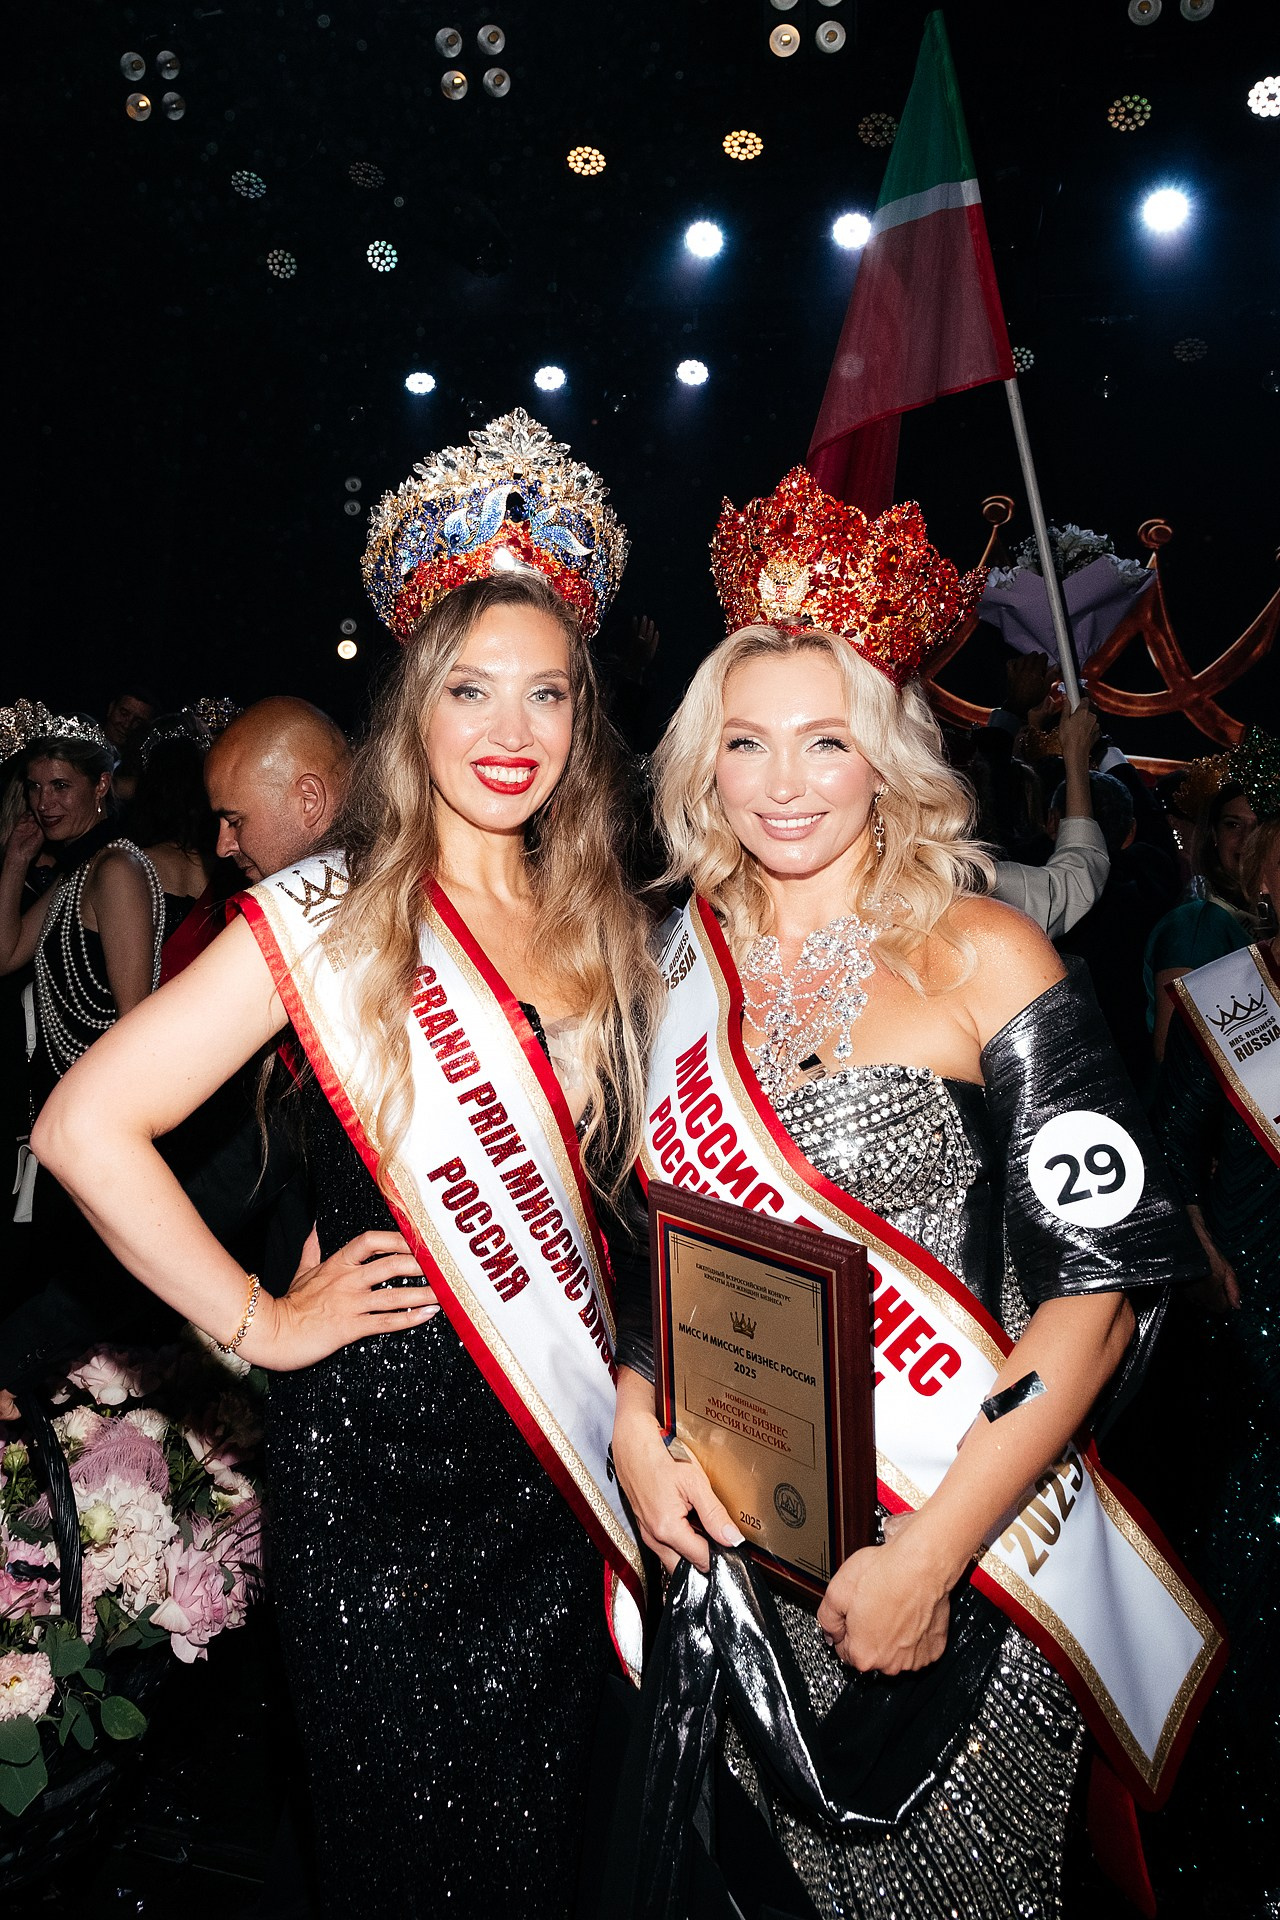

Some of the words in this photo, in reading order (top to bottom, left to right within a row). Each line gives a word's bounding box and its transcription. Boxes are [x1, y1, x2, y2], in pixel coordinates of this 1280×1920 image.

[1229, 1035, 1246, 1048] MRS.
[1245, 1015, 1276, 1038] BUSINESS
[1234, 1024, 1280, 1062] RUSSIA
[410, 965, 481, 1084] GRAND
[457, 1081, 527, 1167] PRIX
[500, 1159, 590, 1302] МИССИС
[675, 1032, 785, 1216] МИССИС
[1044, 1143, 1126, 1206] 29
[427, 1156, 531, 1303] РОССИЯ
[695, 1262, 726, 1278] ЕЖЕГОДНЫЙ
[725, 1273, 767, 1292] ВСЕРОССИЙСКИЙ
[767, 1288, 791, 1302] КОНКУРС
[703, 1272, 726, 1285] КРАСОТЫ
[725, 1281, 736, 1289] ДЛЯ
[736, 1284, 760, 1299] ЖЕНЩИН
[760, 1293, 783, 1306] БИЗНЕСА
[678, 1322, 701, 1339] МИСС
[702, 1331, 709, 1342] И
[710, 1335, 745, 1357] МИССИС
[745, 1349, 779, 1372] БИЗНЕС
[780, 1364, 817, 1387] РОССИЯ
[733, 1361, 757, 1379] 2025
[707, 1396, 751, 1422] «МИССИС
[752, 1414, 789, 1439] БИЗНЕС
[725, 1391, 769, 1416] НОМИНАЦИЯ:
[705, 1406, 741, 1431] РОССИЯ
[741, 1422, 792, 1453] КЛАССИК»
[739, 1510, 762, 1531] 2025
[1000, 1451, 1083, 1577] 2025
